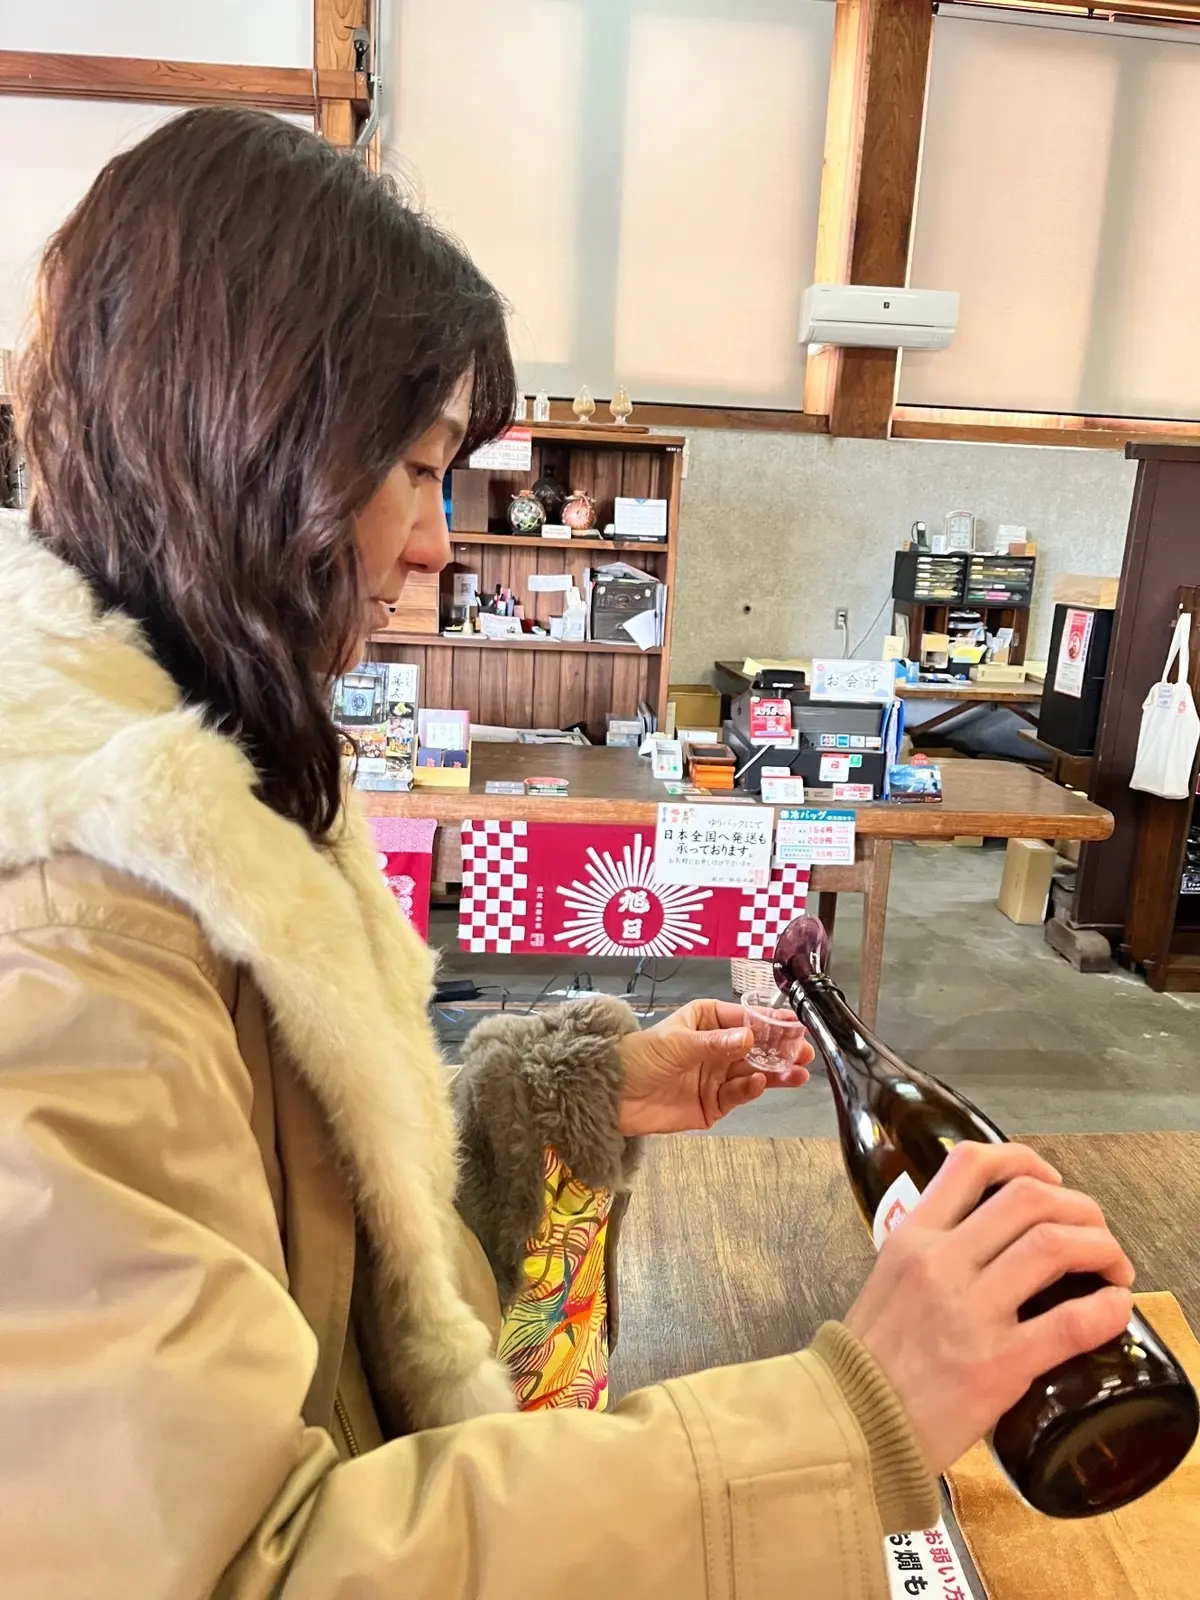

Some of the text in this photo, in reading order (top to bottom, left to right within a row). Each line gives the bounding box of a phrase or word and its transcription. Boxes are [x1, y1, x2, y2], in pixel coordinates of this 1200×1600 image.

[826, 674, 879, 690] お会計
[664, 828, 767, 845] 日本全国へ発送も
[676, 842, 754, 858] 承っております。
[618, 889, 651, 939] 旭日
